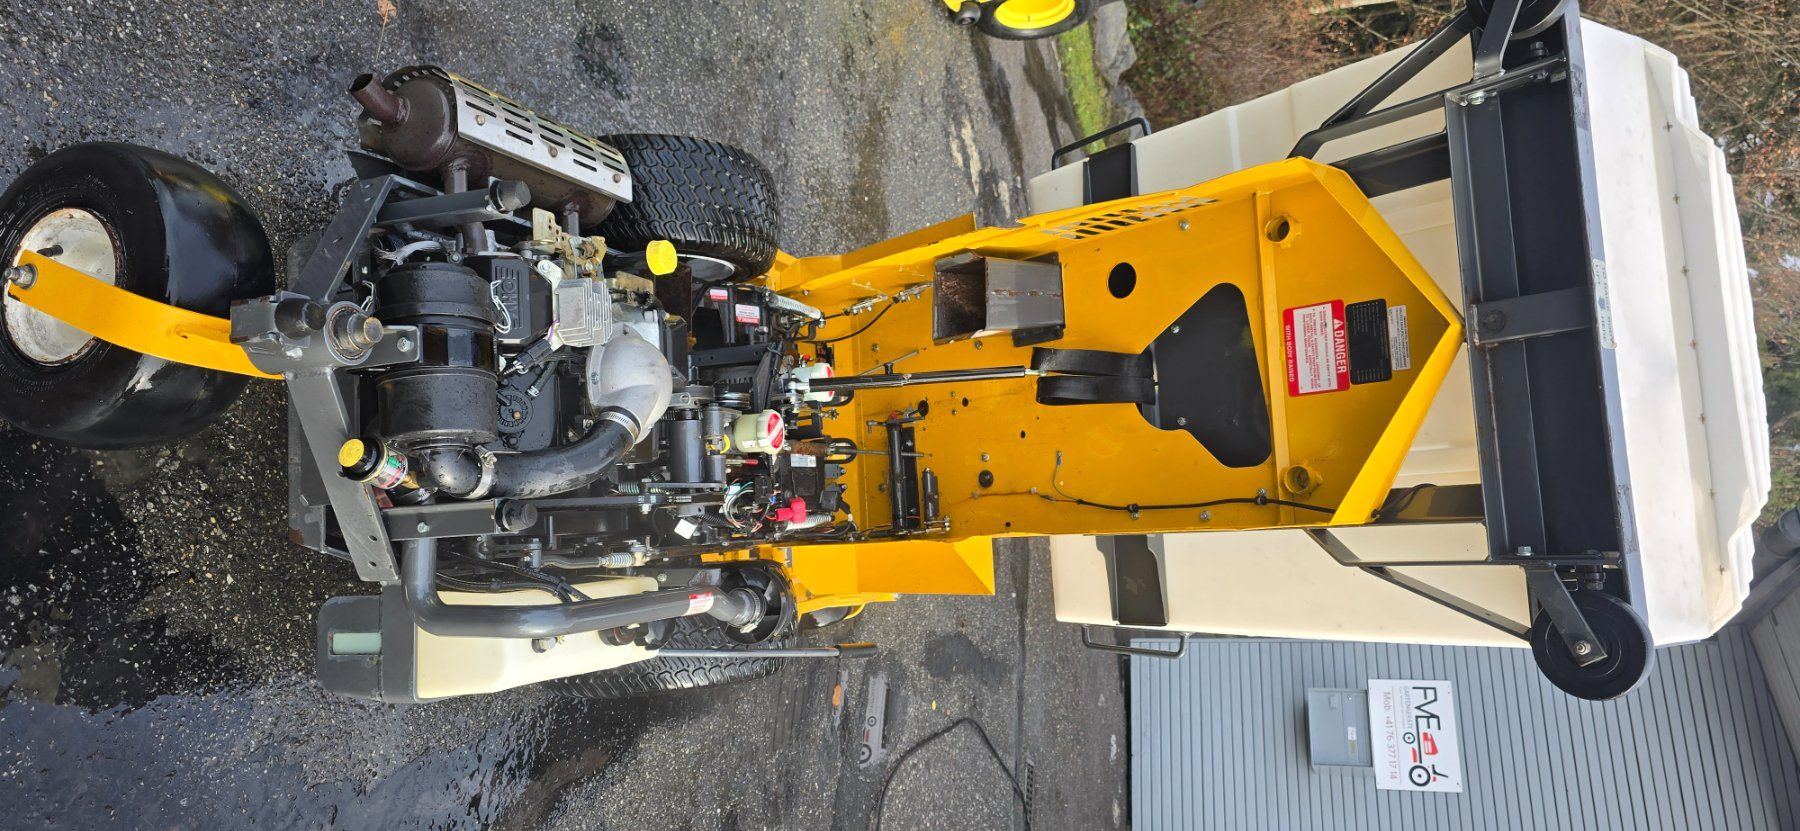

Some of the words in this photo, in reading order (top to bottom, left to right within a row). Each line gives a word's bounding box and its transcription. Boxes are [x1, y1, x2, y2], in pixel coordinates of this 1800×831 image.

[1335, 330, 1347, 374] DANGER
[1412, 686, 1441, 730] FVE
[1385, 715, 1393, 728] +41
[1386, 730, 1394, 741] 76
[1387, 743, 1395, 759] 377
[1389, 761, 1396, 769] 17
[1390, 771, 1398, 780] 14
